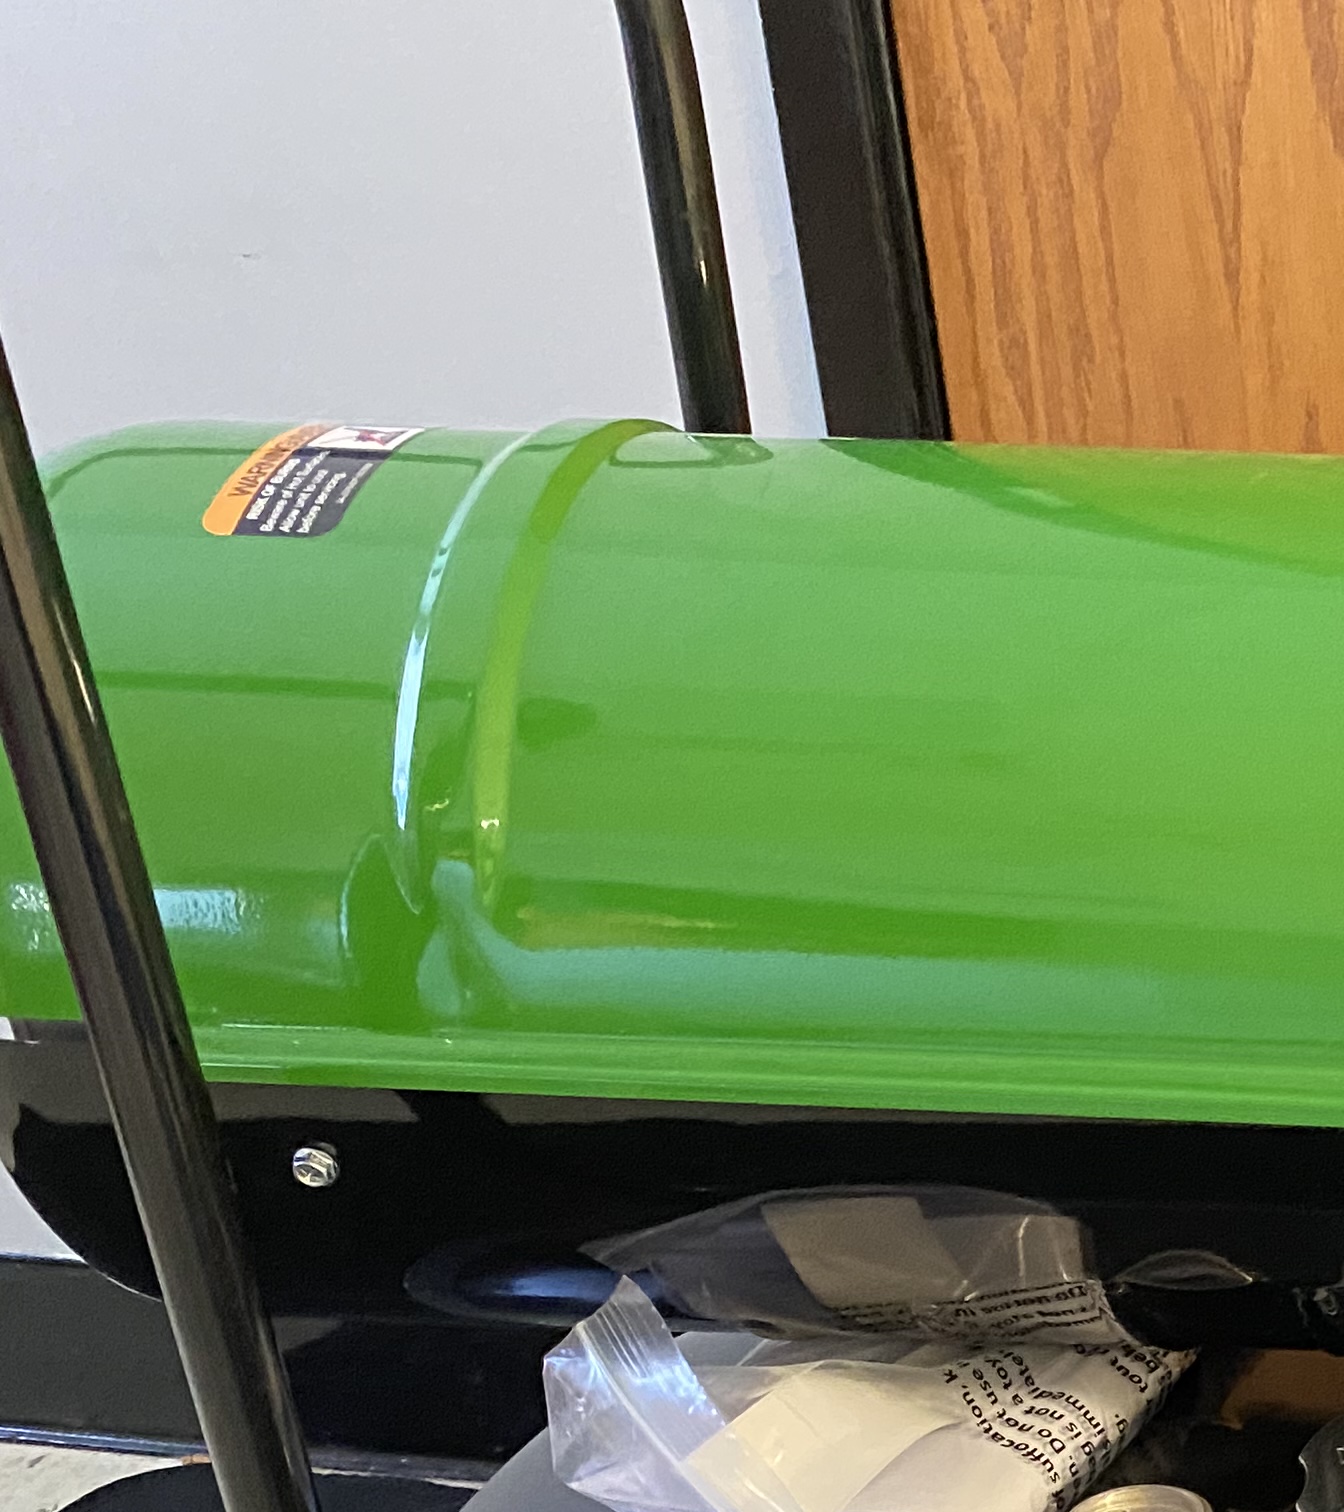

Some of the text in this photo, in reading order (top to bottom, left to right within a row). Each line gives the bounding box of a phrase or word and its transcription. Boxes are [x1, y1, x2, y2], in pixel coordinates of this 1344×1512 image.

[1109, 1356, 1148, 1393] tout
[973, 1368, 1065, 1454] Do not use
[1003, 1351, 1105, 1438] immediatel
[1012, 1393, 1023, 1405] a
[1024, 1404, 1064, 1421] not
[962, 1385, 1060, 1484] suffocation,
[1066, 1422, 1082, 1440] is
